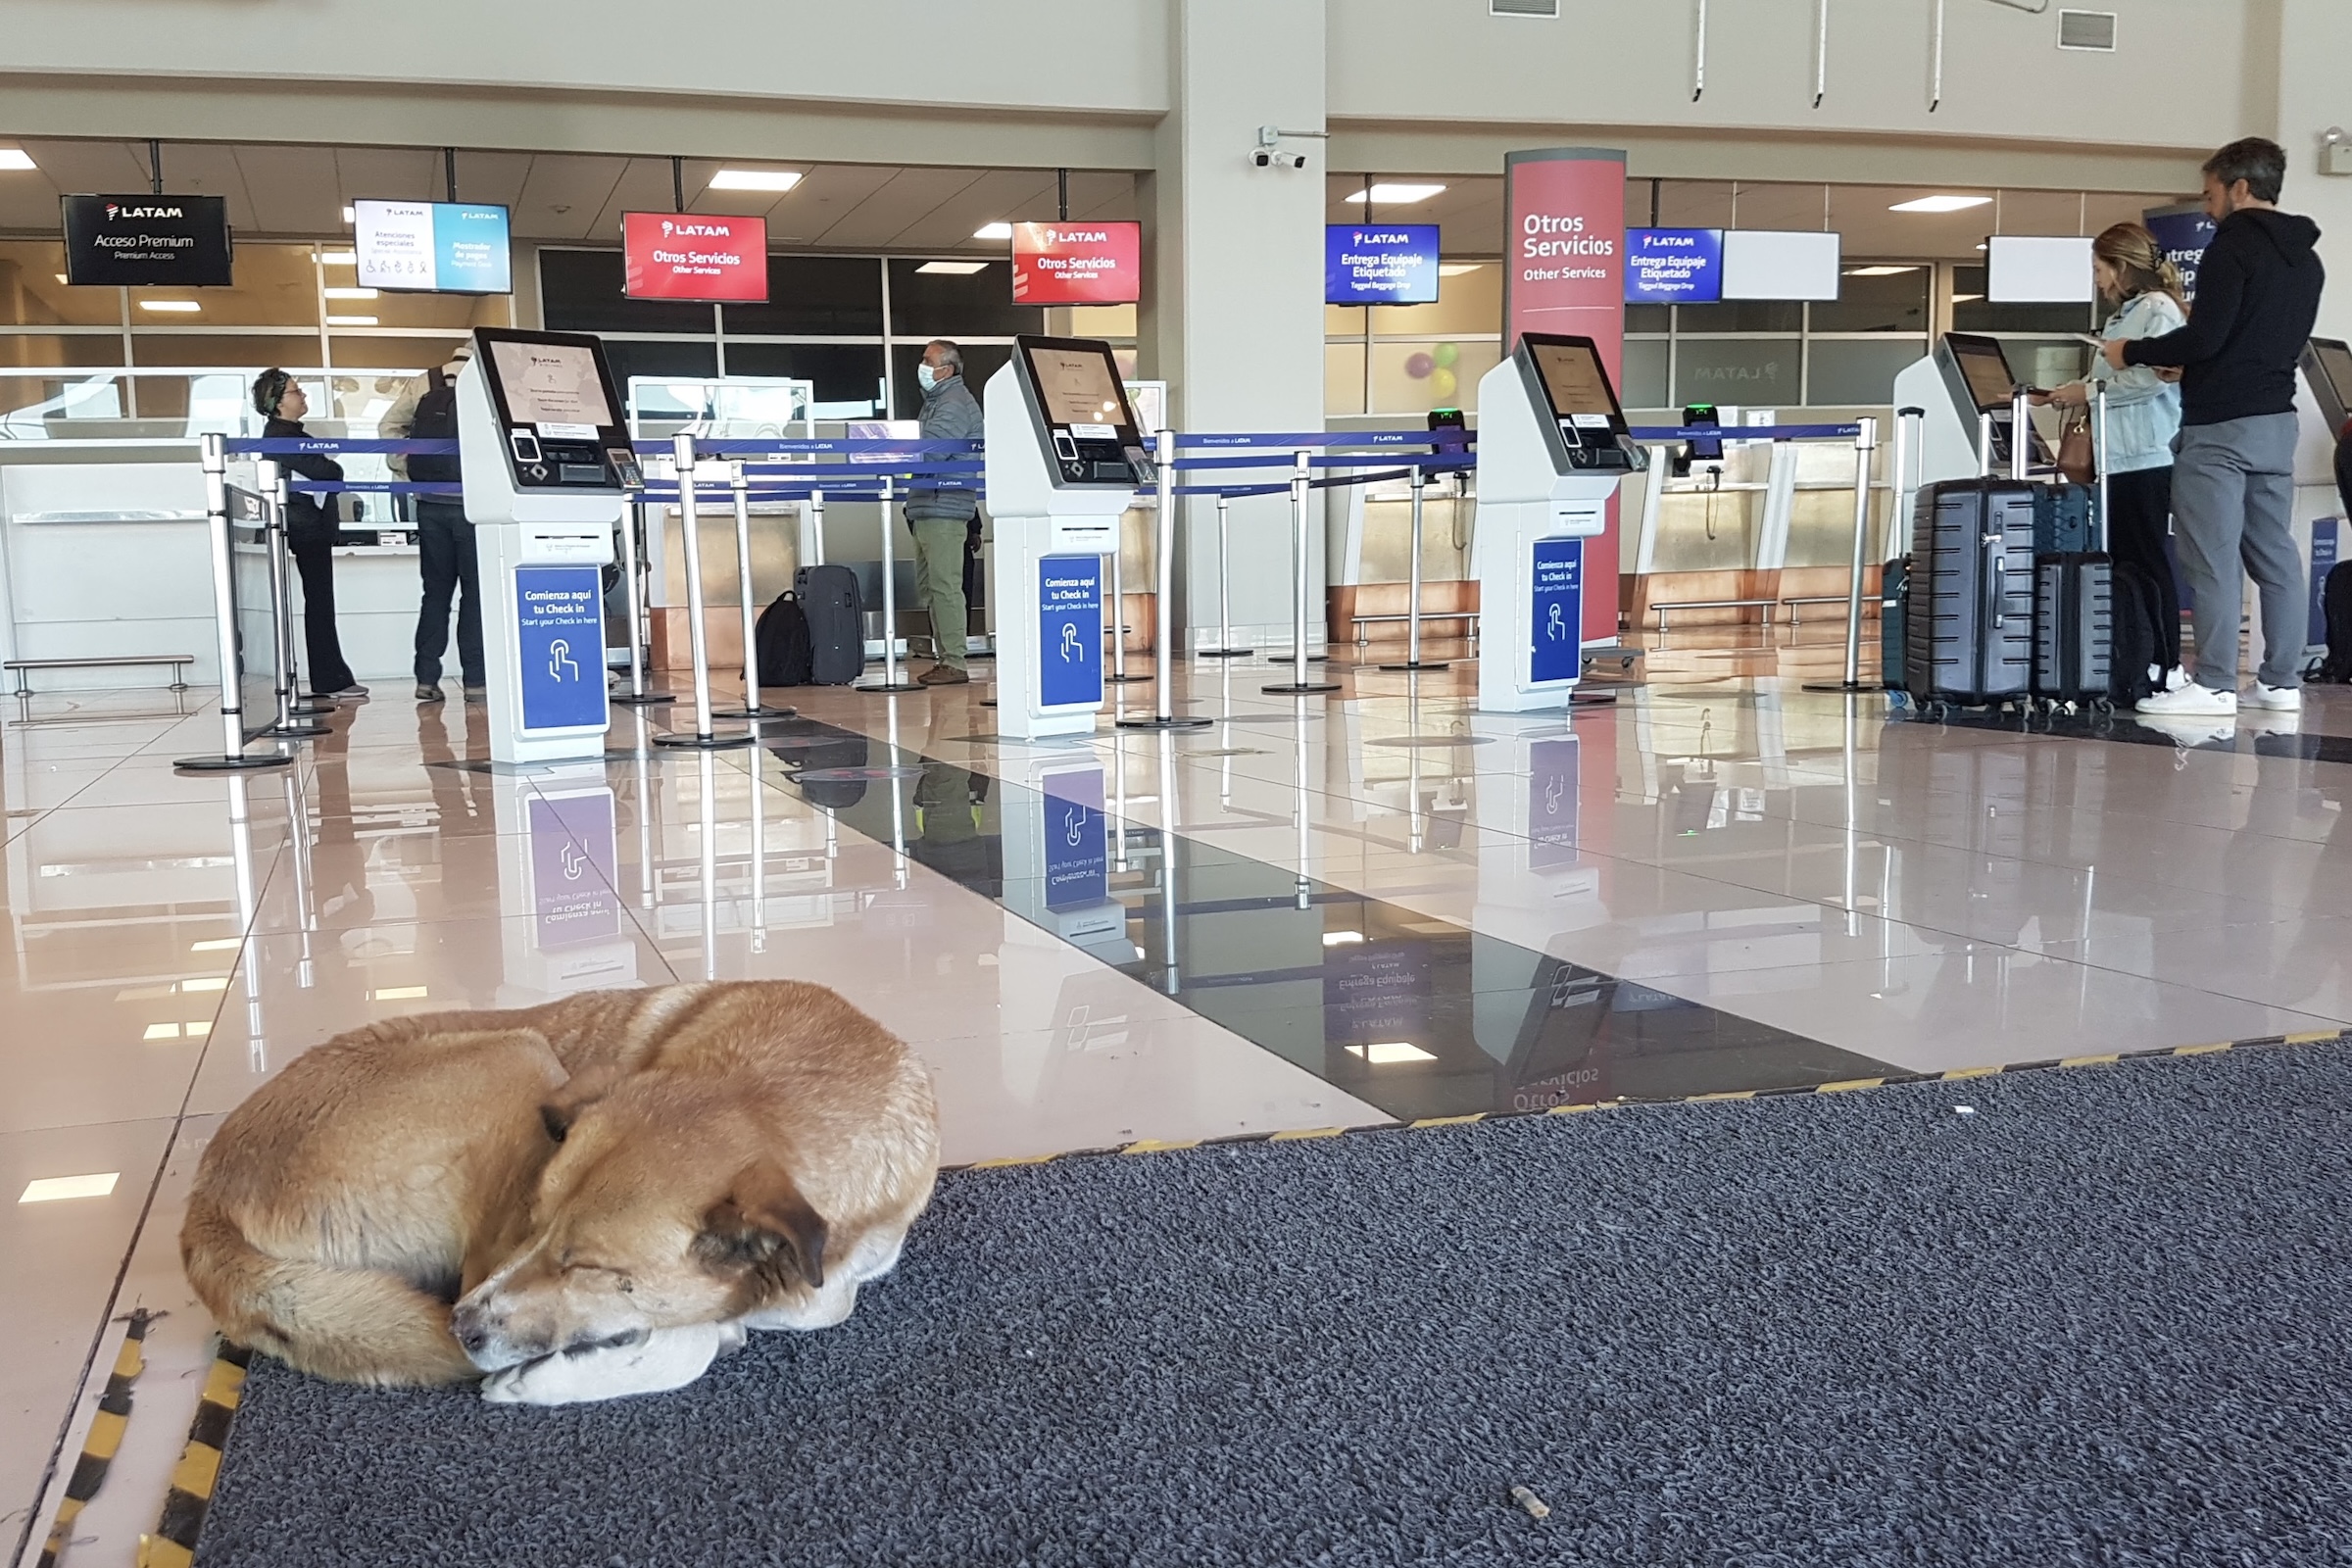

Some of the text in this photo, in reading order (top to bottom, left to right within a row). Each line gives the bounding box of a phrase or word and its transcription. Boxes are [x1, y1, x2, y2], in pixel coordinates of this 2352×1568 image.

[122, 207, 183, 219] LATAM
[676, 225, 729, 236] LATAM
[1524, 215, 1584, 234] Otros
[94, 234, 194, 248] Acceso Premium
[1058, 232, 1107, 242] LATAM
[1364, 234, 1409, 244] LATAM
[1653, 237, 1694, 246] LATAM
[453, 242, 492, 251] Mostrador
[1524, 235, 1613, 258] Servicios
[114, 251, 147, 260] Premium
[653, 250, 741, 265] Otros Servicios
[1342, 253, 1423, 268] Entrega Equipaje
[1038, 257, 1115, 270] Otros Servicios
[1631, 256, 1706, 270] Entrega Equipaje
[1352, 267, 1406, 280] Etiquetado
[1524, 267, 1606, 281] Other Services
[1641, 268, 1691, 281] Etiquetado
[1548, 571, 1565, 581] Check
[1566, 571, 1572, 580] in
[1045, 576, 1096, 589] Comienza aquí
[524, 589, 592, 602] Comienza aquí
[1051, 590, 1090, 600] tu Check in
[533, 604, 585, 614] tu Check in
[1055, 604, 1066, 612] your
[539, 618, 555, 627] your
